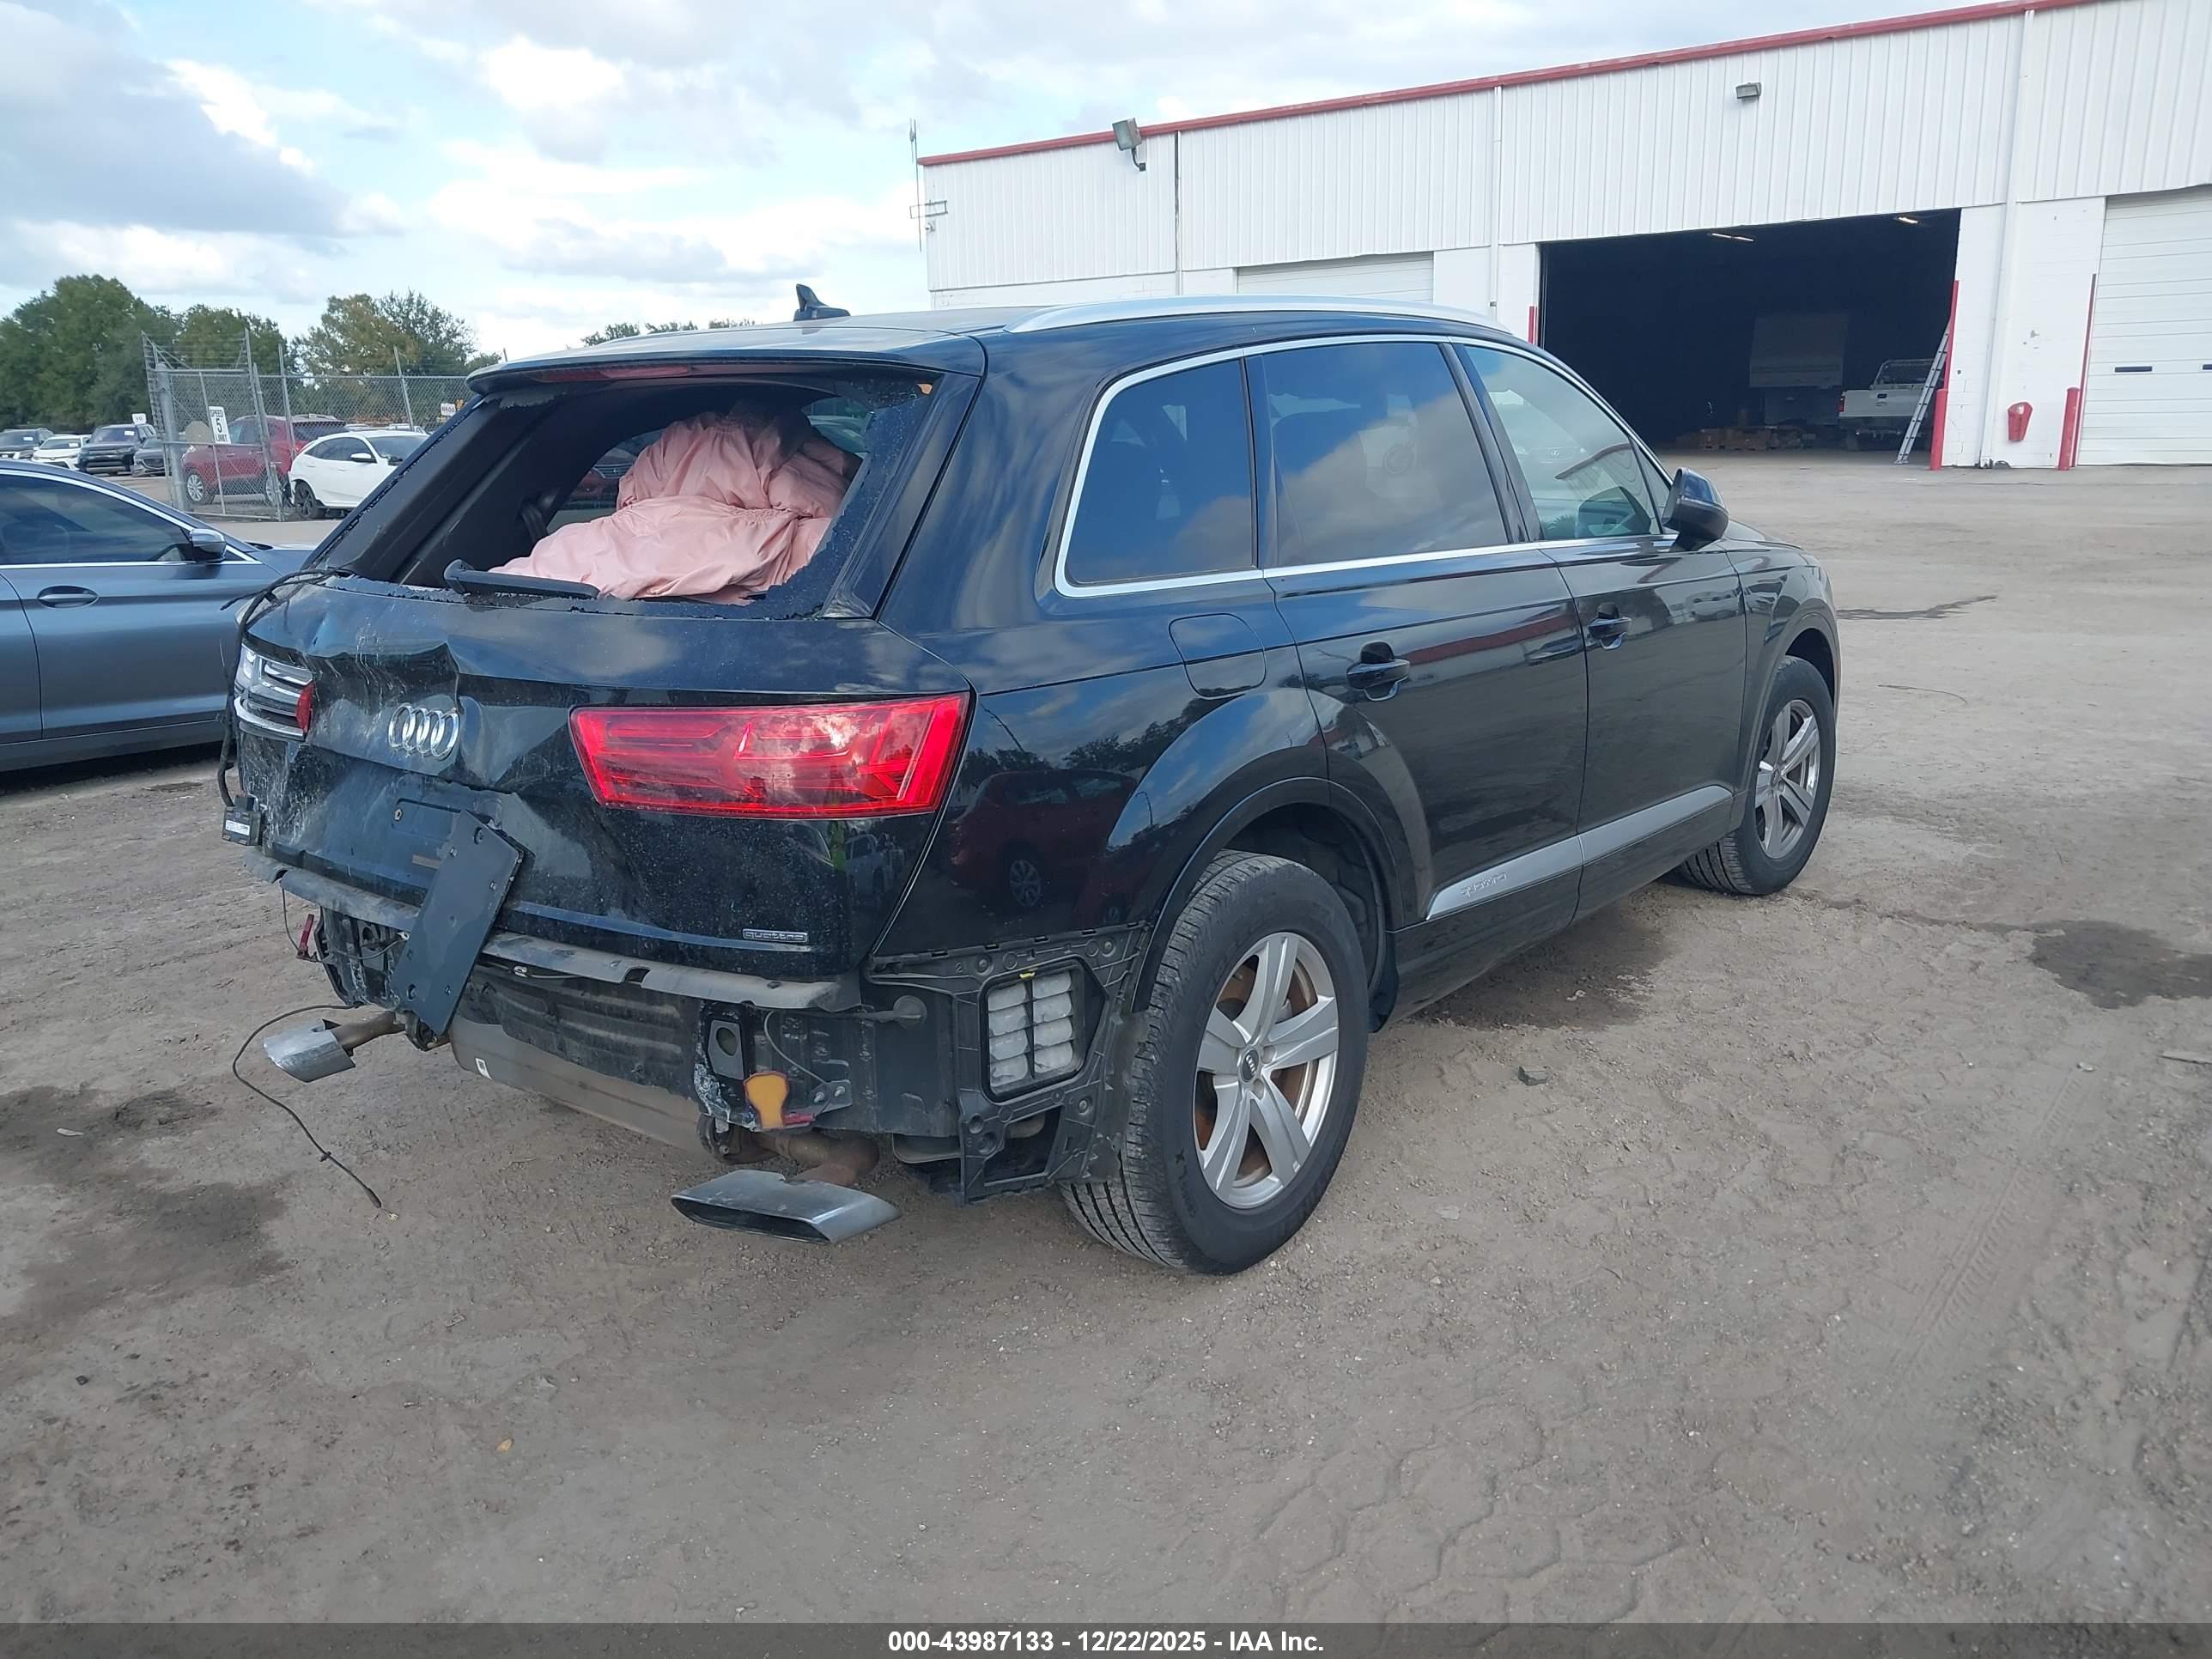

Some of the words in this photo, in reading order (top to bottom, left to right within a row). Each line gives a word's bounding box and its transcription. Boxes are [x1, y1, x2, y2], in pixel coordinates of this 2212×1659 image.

[210, 409, 223, 417] SPEED
[216, 417, 222, 433] 5
[215, 434, 228, 442] LIMIT
[744, 930, 805, 942] quattro
